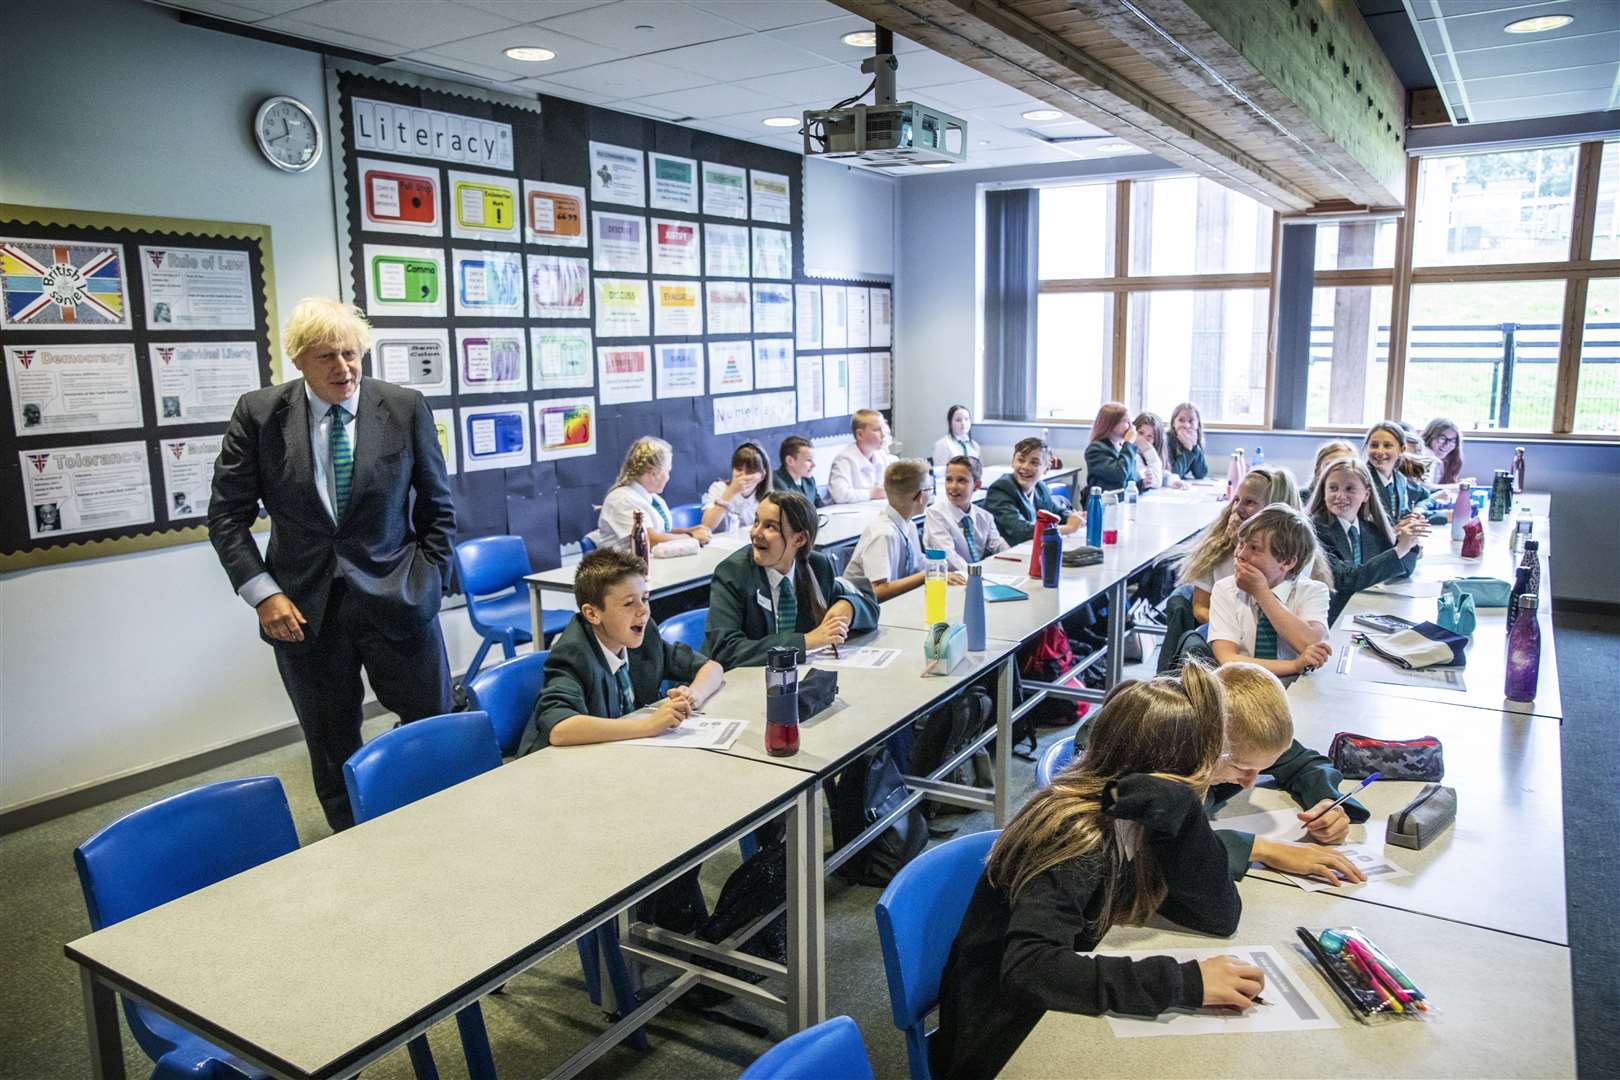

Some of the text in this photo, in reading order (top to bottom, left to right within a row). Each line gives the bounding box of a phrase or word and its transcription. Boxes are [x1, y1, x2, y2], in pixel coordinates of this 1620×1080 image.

[359, 113, 495, 160] Literacy
[167, 253, 245, 271] Rule of Law
[406, 264, 435, 274] Comma
[43, 263, 80, 286] British
[50, 284, 87, 306] Values
[41, 352, 126, 366] Democracy
[52, 451, 142, 470] Tolerance
